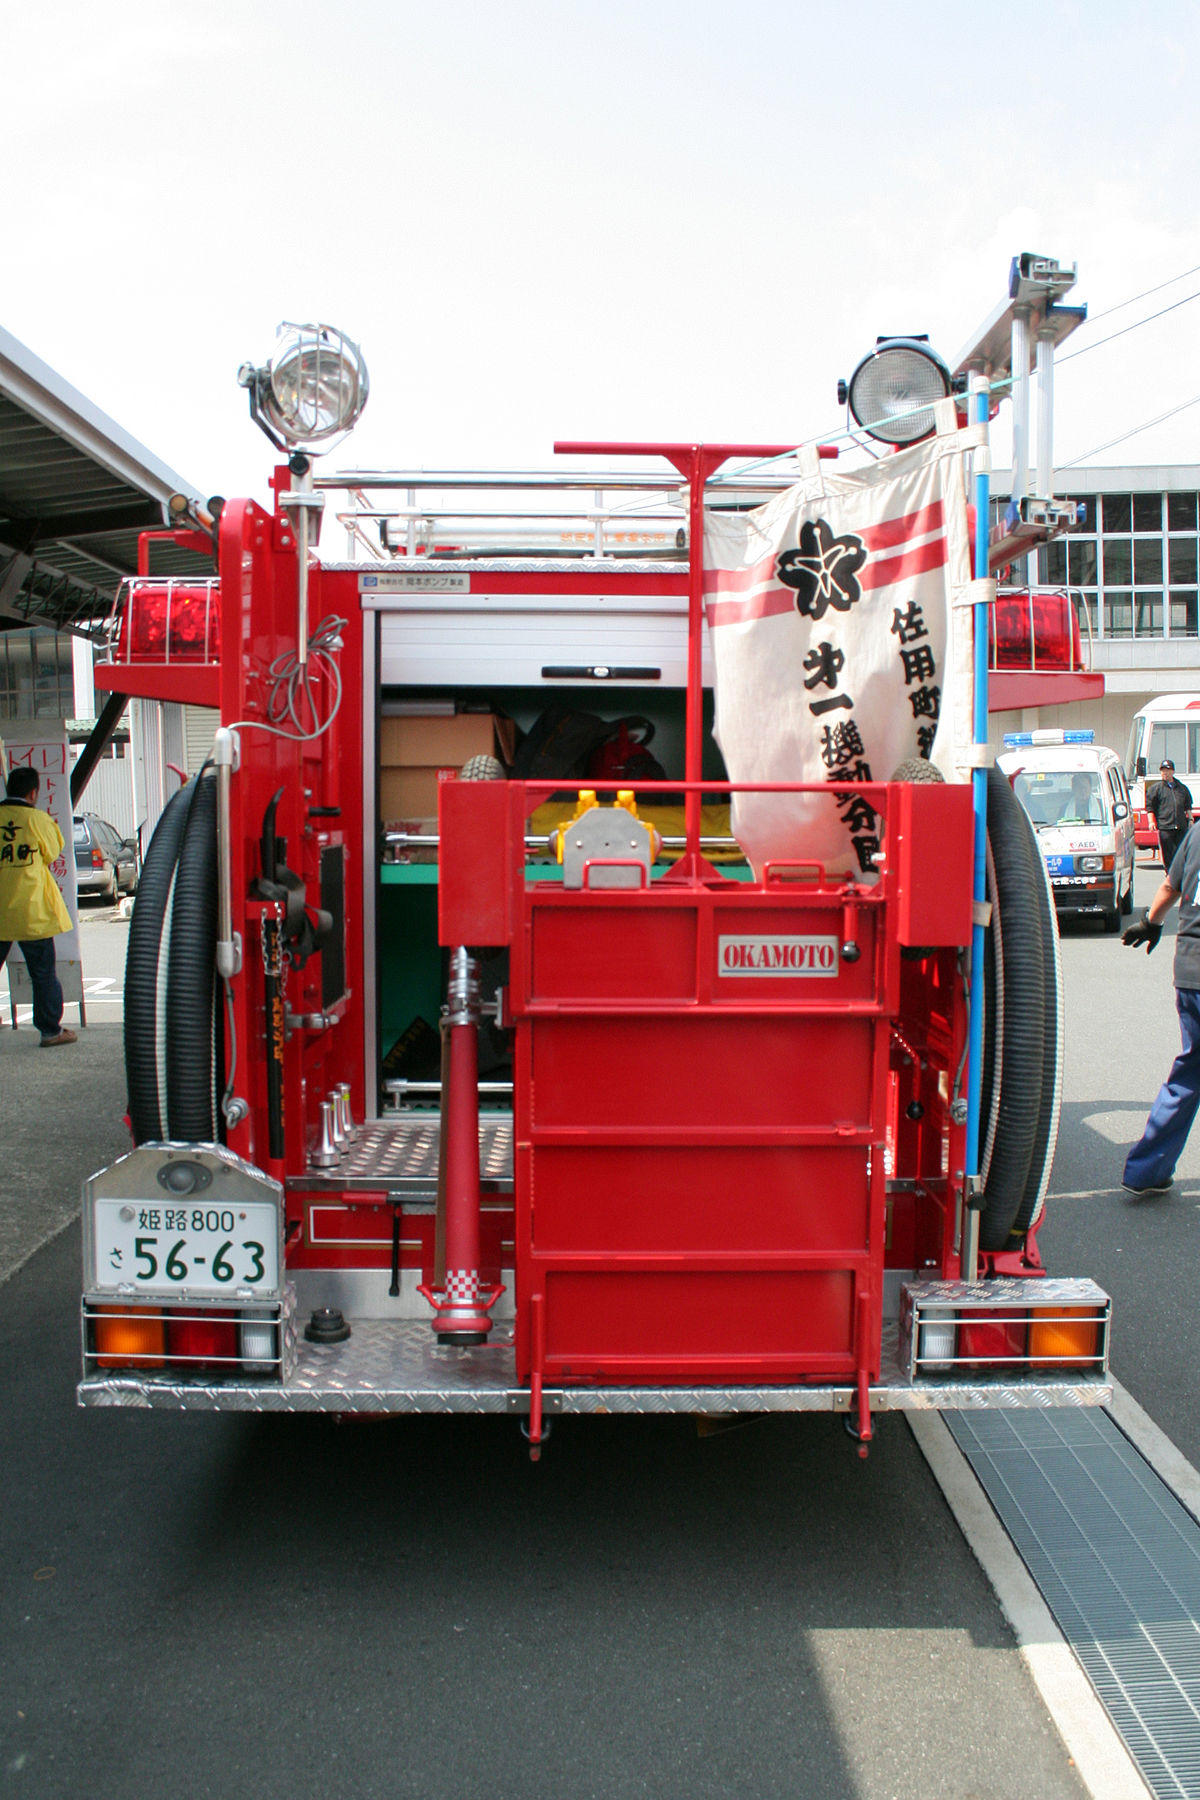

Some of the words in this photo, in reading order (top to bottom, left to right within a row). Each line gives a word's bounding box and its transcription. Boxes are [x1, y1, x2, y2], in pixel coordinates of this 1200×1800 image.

[9, 747, 59, 770] トイレ
[724, 944, 835, 968] OKAMOTO
[110, 1247, 122, 1269] さ
[135, 1238, 265, 1283] 56-63
